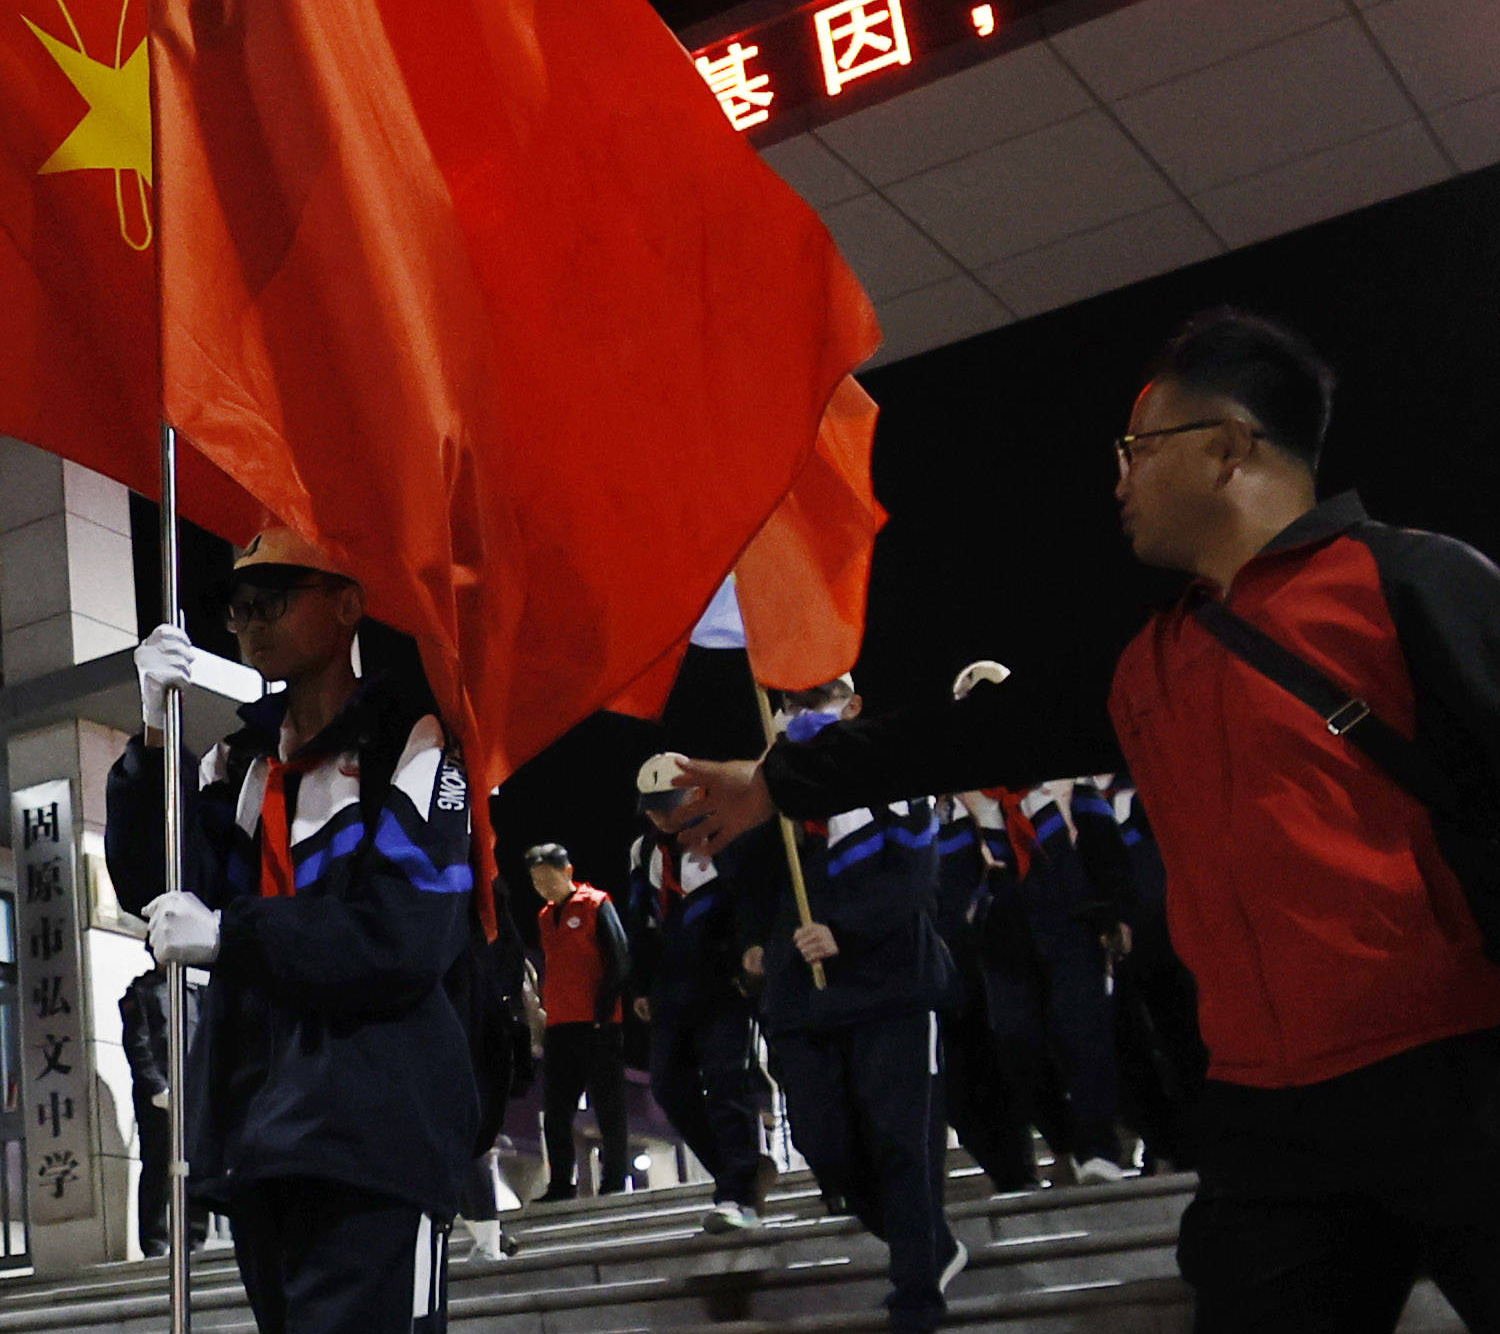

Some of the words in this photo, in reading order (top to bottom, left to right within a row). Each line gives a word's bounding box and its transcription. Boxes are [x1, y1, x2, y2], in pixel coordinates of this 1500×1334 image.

[21, 800, 80, 1199] 固原市弘文中学
